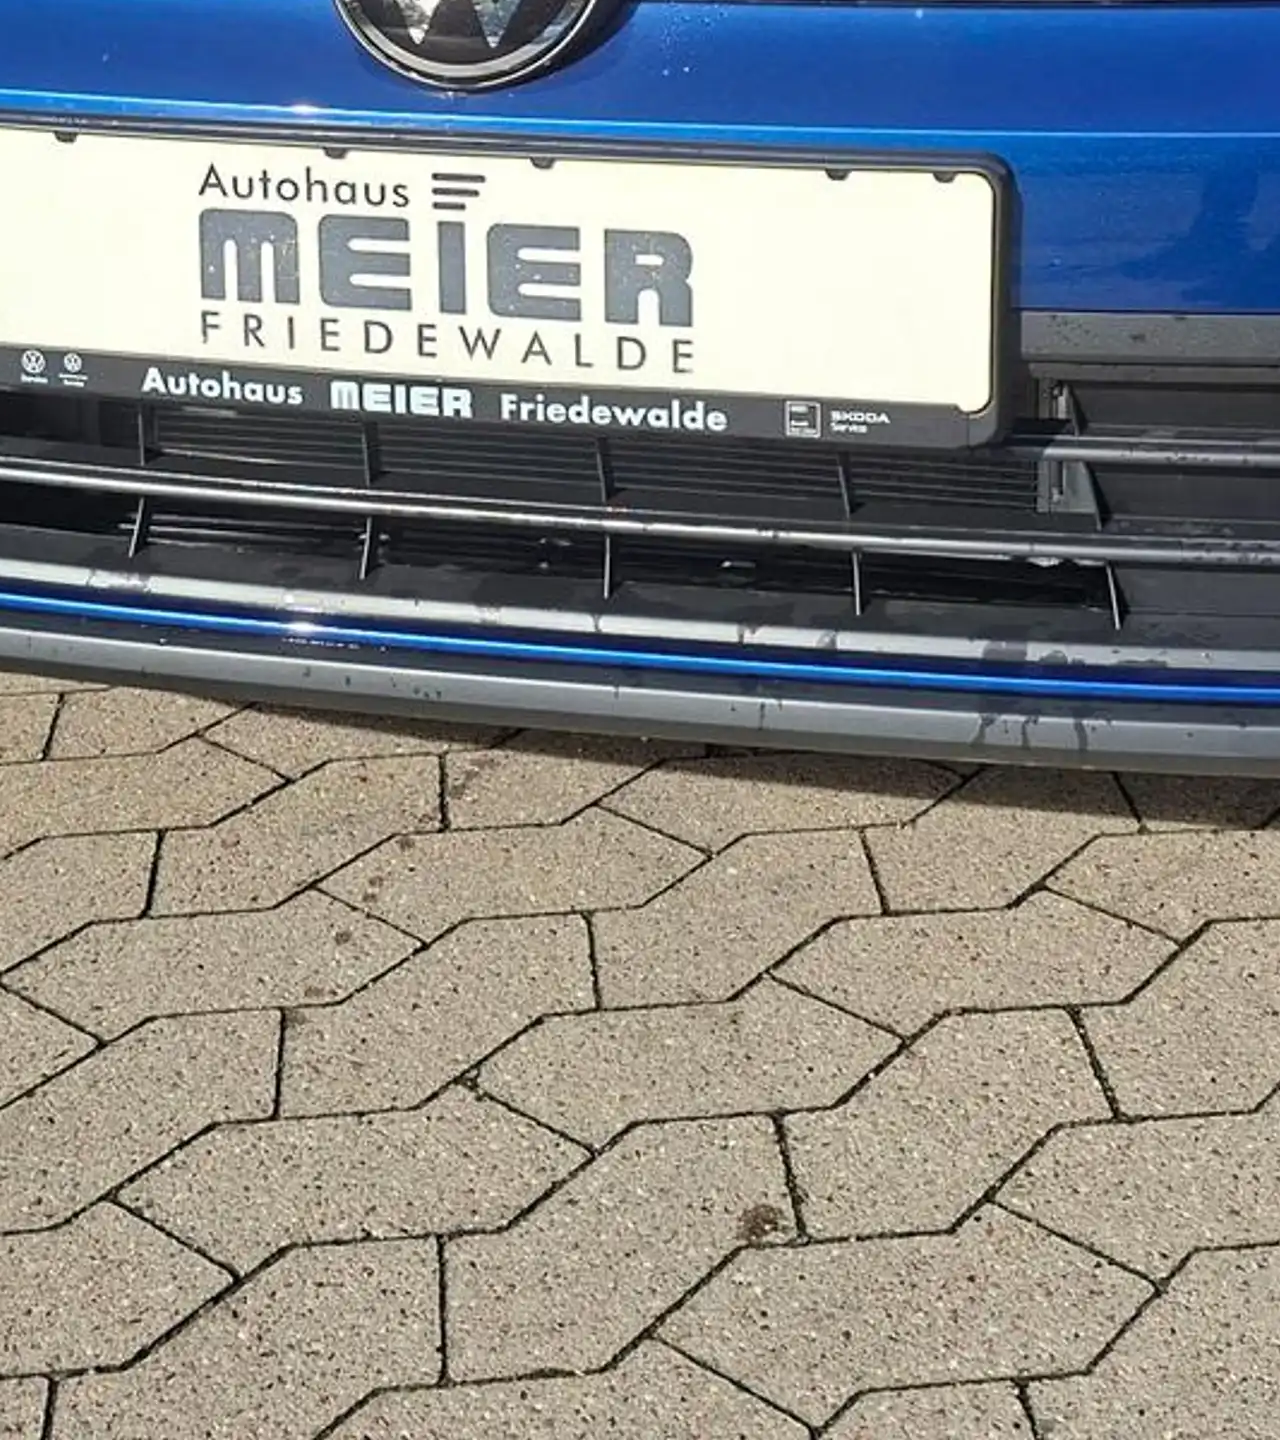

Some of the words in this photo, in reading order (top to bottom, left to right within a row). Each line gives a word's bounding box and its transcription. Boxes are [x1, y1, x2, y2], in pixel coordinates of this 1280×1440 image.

[198, 163, 409, 208] Autohaus
[201, 310, 694, 373] FRIEDEWALDE
[141, 367, 303, 404] Autohaus
[330, 381, 473, 418] MEIER
[501, 393, 728, 431] Friedewalde
